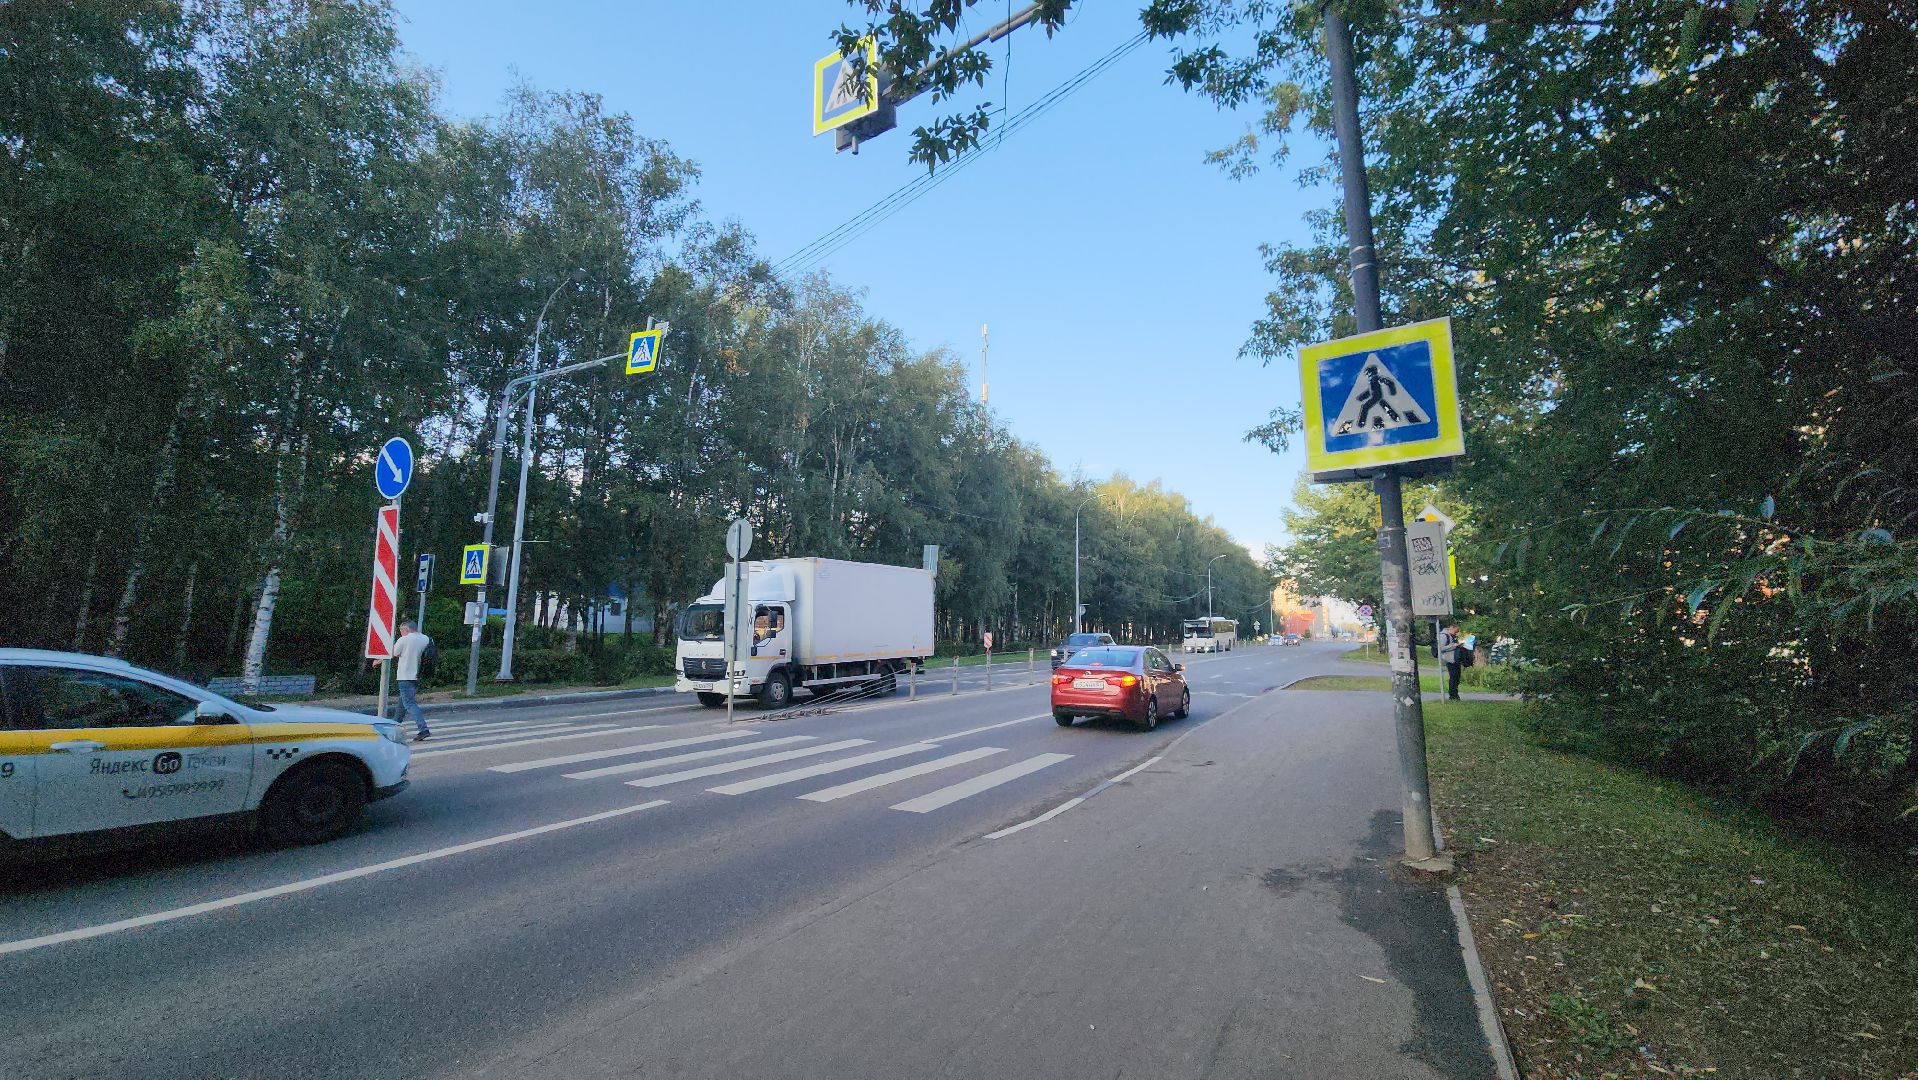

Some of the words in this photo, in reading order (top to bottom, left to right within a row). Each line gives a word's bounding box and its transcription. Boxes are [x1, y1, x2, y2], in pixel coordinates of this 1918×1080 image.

[89, 757, 150, 775] Яндекс
[157, 755, 180, 772] Go
[186, 753, 227, 769] Такси
